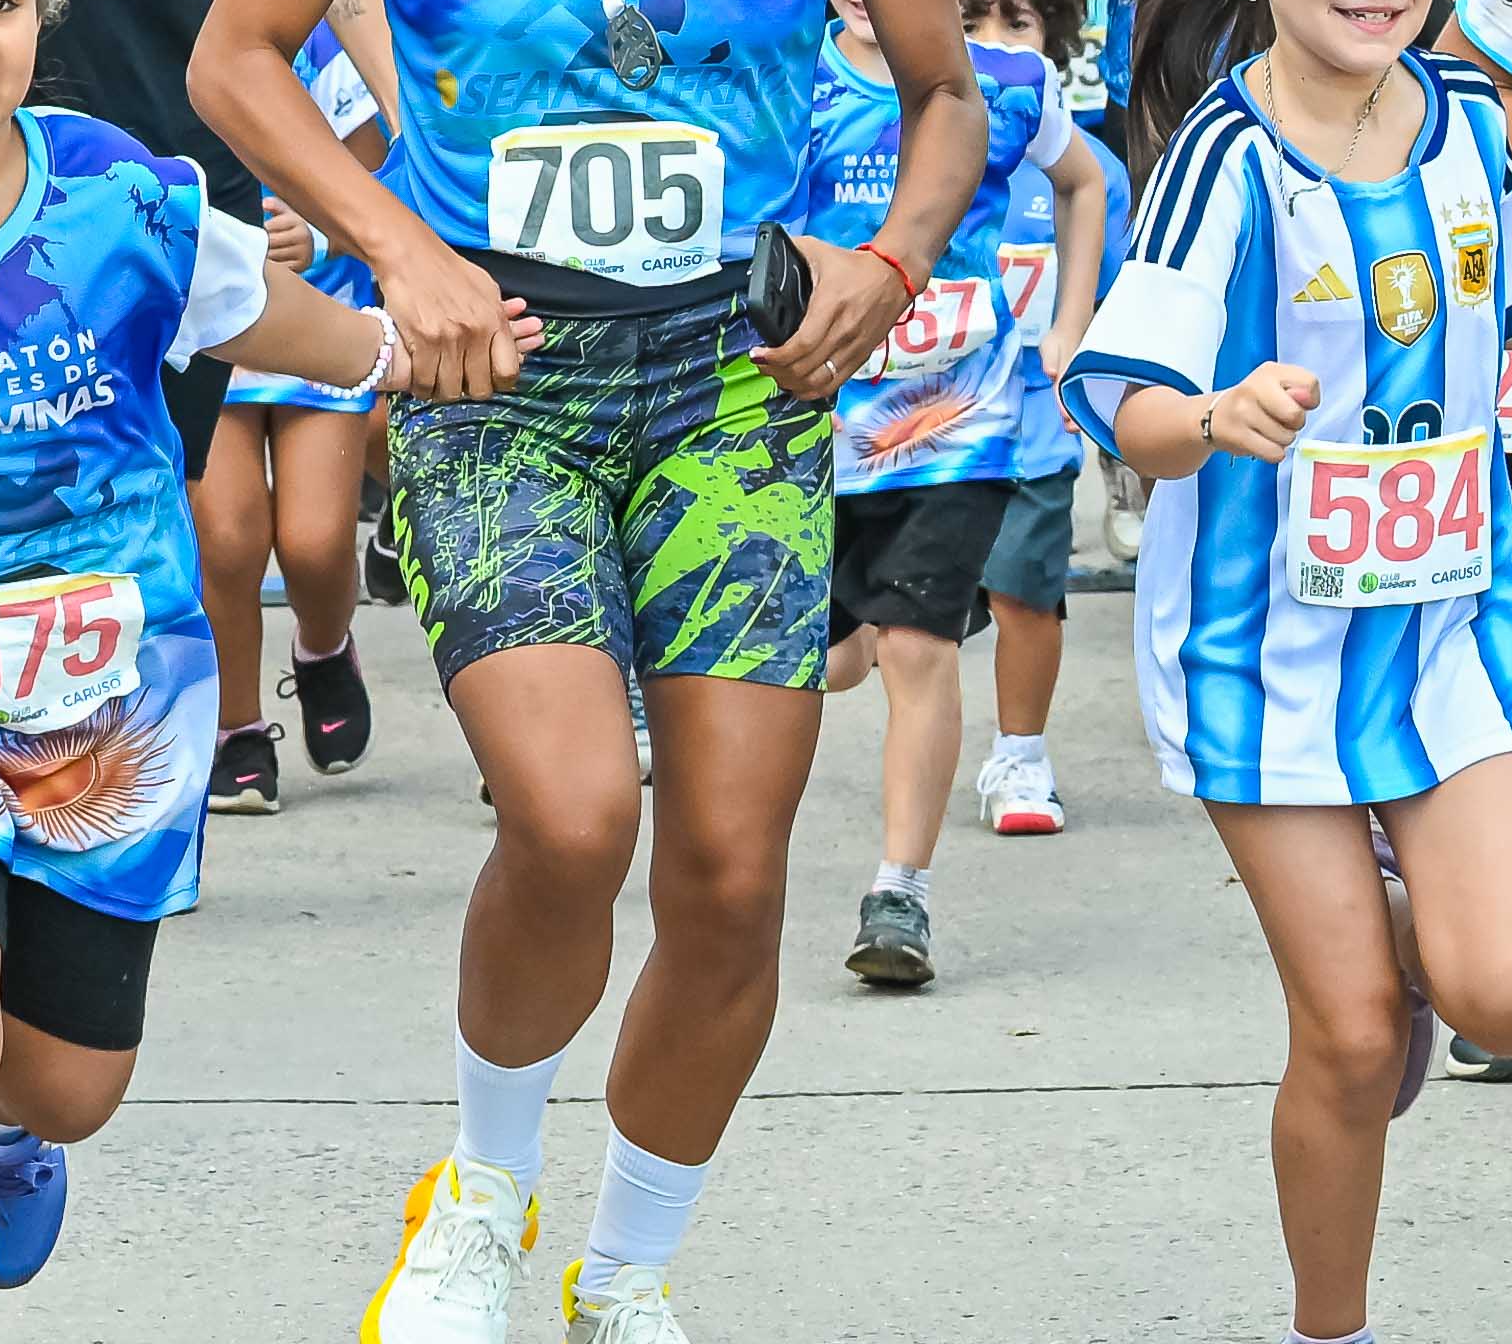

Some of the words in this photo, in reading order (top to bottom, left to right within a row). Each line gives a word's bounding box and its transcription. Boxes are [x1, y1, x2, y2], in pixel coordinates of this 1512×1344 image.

[505, 140, 703, 249] 705
[834, 182, 892, 205] MALV
[641, 253, 703, 272] CARUSO
[1000, 256, 1044, 318] 7
[876, 281, 977, 354] 67
[64, 356, 99, 385] DE
[1307, 448, 1485, 565] 584
[1431, 564, 1483, 585] CARUSO
[62, 677, 122, 708] CARUSO
